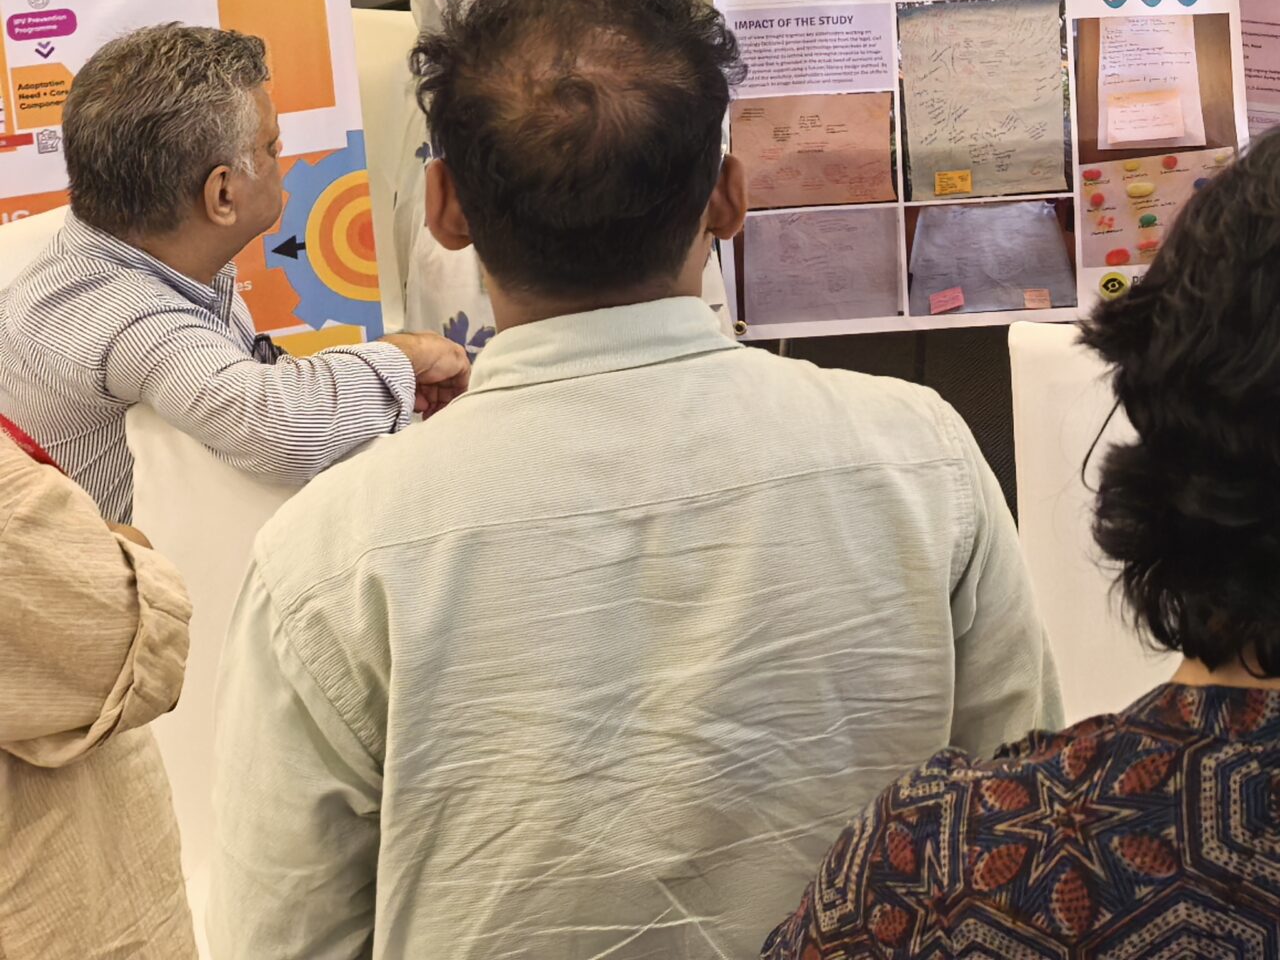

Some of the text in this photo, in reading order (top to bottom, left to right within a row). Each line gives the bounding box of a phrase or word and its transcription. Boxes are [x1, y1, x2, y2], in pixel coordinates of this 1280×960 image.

[735, 15, 854, 30] IMPACT OF THE STUDY
